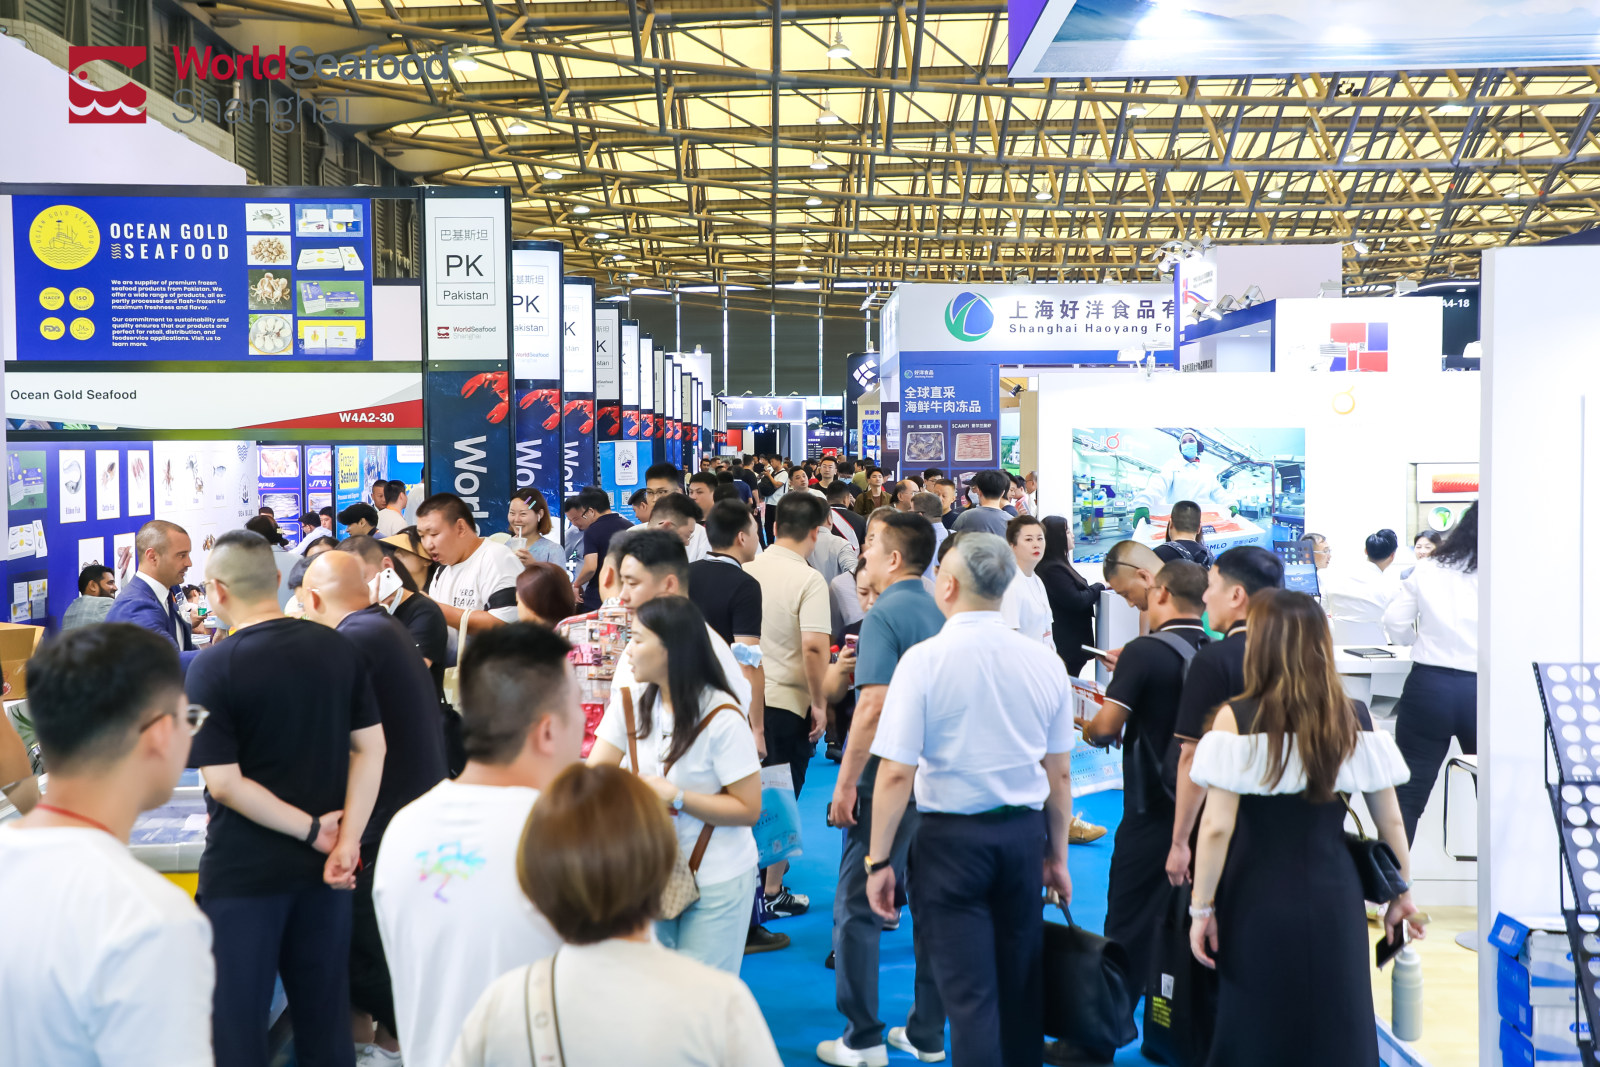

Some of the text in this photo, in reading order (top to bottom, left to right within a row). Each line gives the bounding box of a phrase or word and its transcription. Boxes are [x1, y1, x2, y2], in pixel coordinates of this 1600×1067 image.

[110, 222, 228, 240] OCEAN GOLD
[440, 228, 488, 242] 巴基斯坦
[124, 244, 230, 260] SEAFOOD
[446, 254, 484, 276] PK
[444, 290, 488, 300] Pakistan
[1009, 300, 1174, 320] 上海好洋食品有
[1009, 324, 1078, 334] Shanghai
[1086, 324, 1148, 334] Haoyang
[10, 390, 137, 400] Ocean Gold Seafood
[904, 386, 956, 398] 全球直采
[904, 400, 982, 412] 海鲜牛肉冻品
[340, 413, 394, 422] W4A2-30
[340, 468, 358, 484] Seafood
